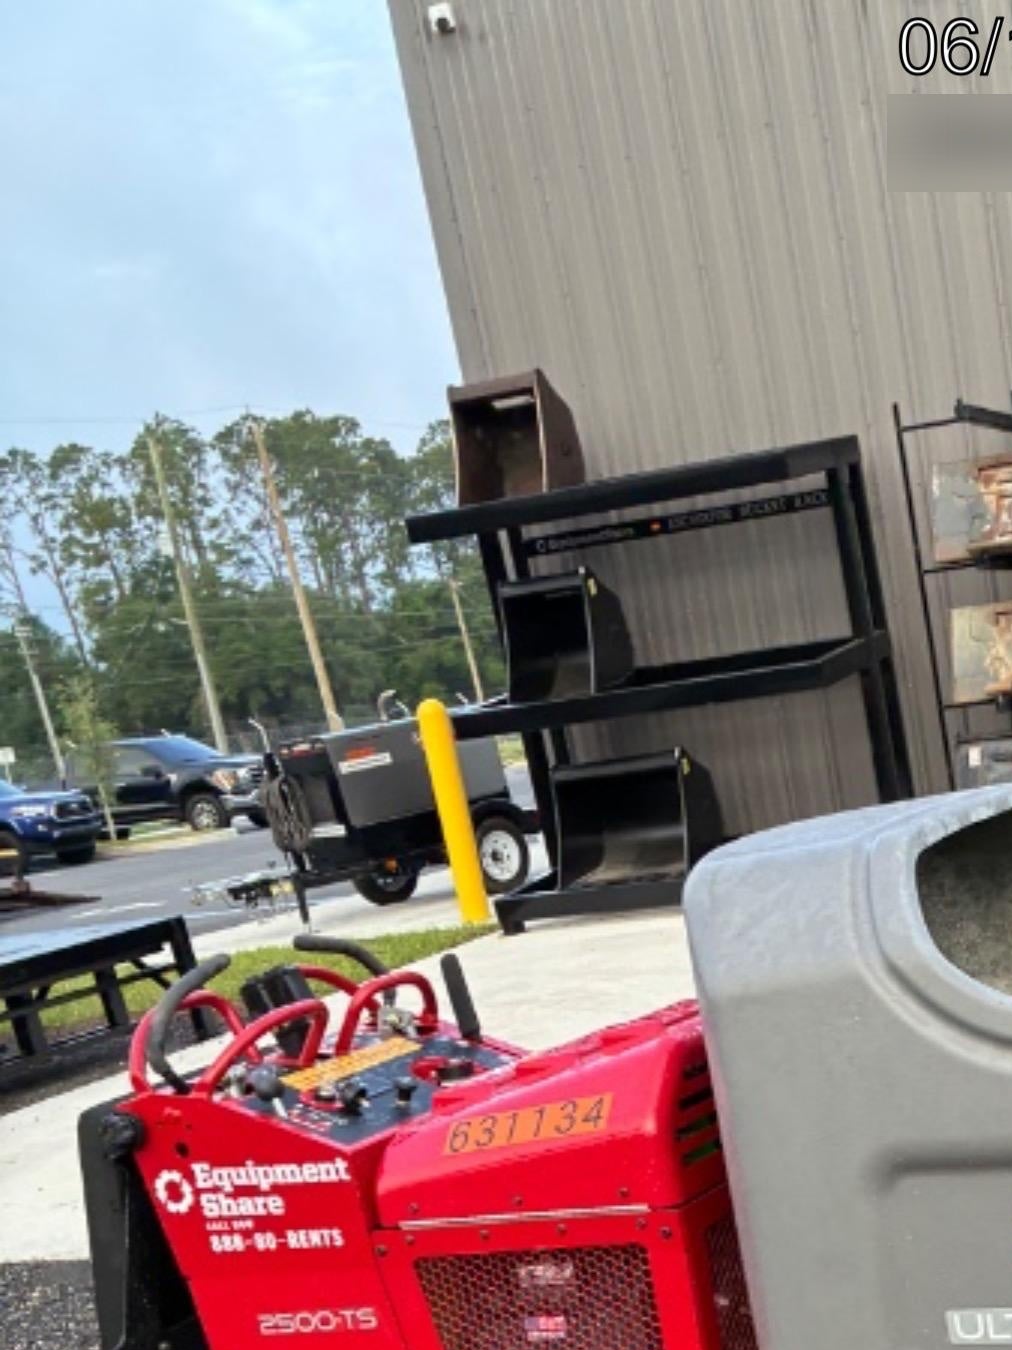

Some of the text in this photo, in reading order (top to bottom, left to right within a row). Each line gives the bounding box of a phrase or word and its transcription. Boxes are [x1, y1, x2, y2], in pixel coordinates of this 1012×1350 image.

[448, 1097, 605, 1153] 631134
[190, 1157, 352, 1193] Equipment
[200, 1192, 286, 1218] Share
